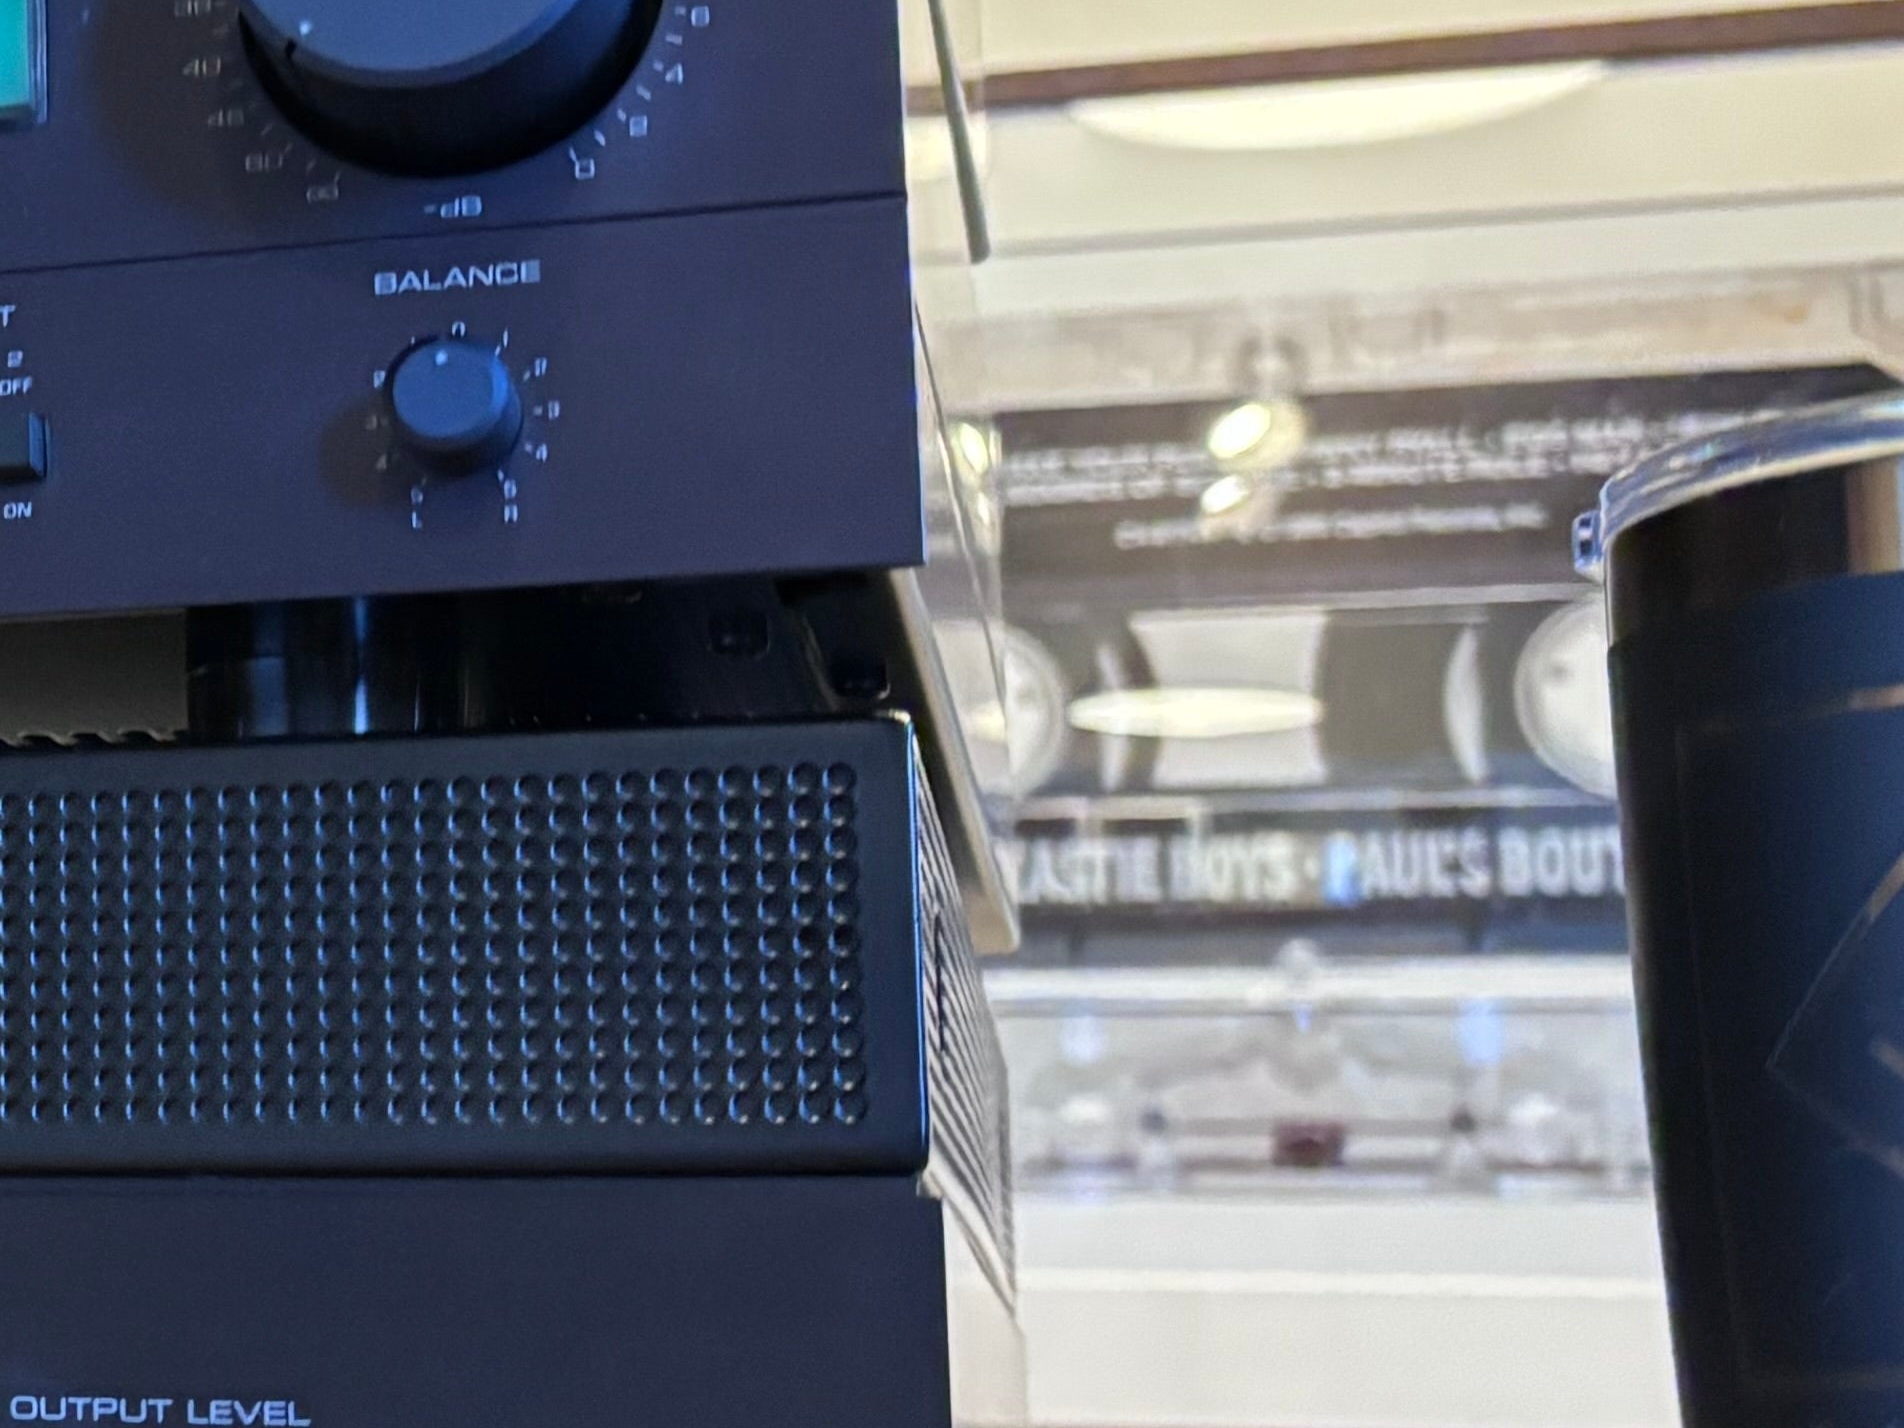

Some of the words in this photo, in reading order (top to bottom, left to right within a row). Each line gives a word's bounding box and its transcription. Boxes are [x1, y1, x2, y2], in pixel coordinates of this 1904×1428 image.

[374, 259, 541, 296] BALANCE
[3, 501, 32, 519] ON
[10, 1396, 173, 1423] OUTPUT
[187, 1399, 312, 1427] LEVEL
